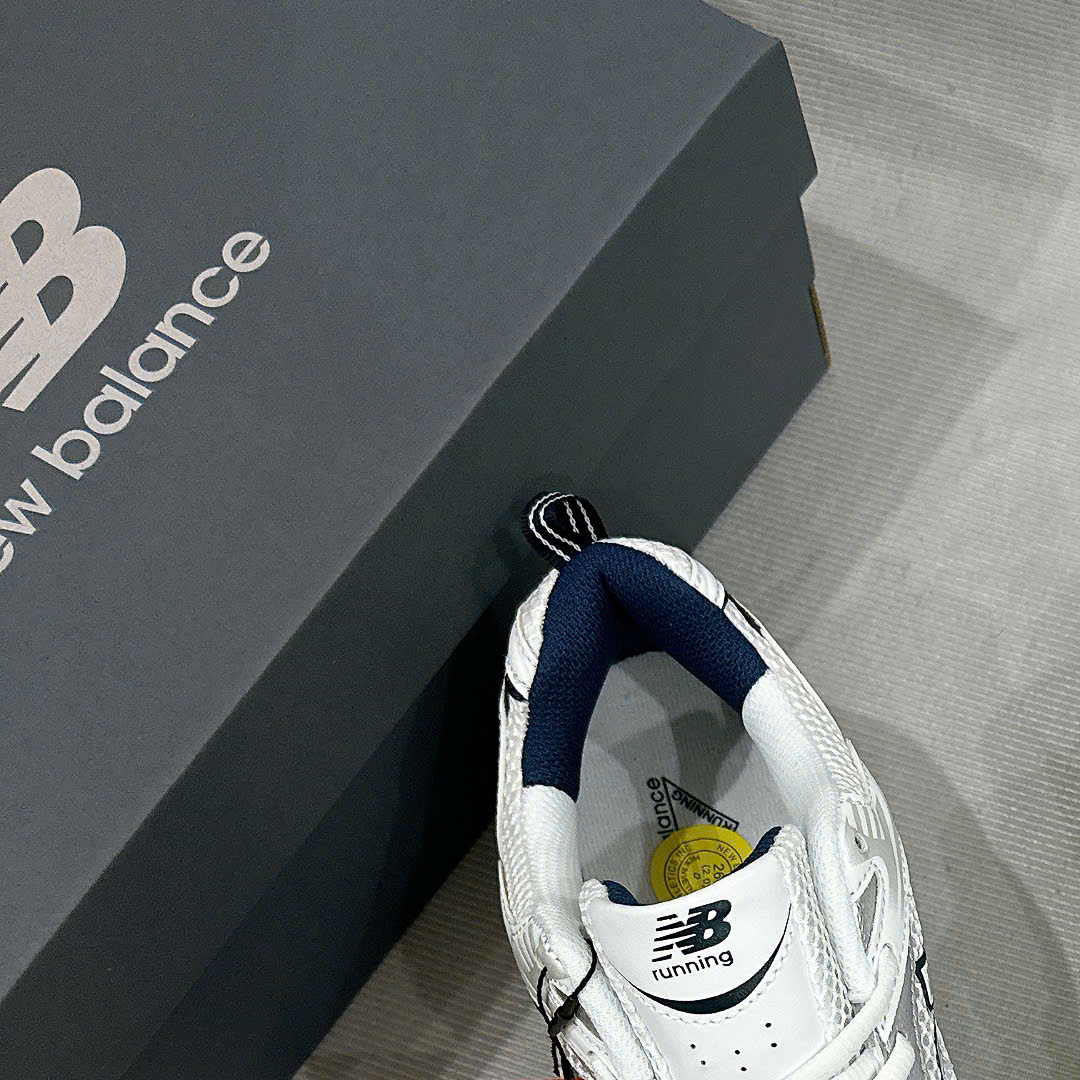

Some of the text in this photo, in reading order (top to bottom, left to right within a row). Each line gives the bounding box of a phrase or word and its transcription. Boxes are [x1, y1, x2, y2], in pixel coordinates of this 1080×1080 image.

[31, 231, 271, 480] balance
[646, 777, 675, 840] lance
[651, 950, 734, 981] running
